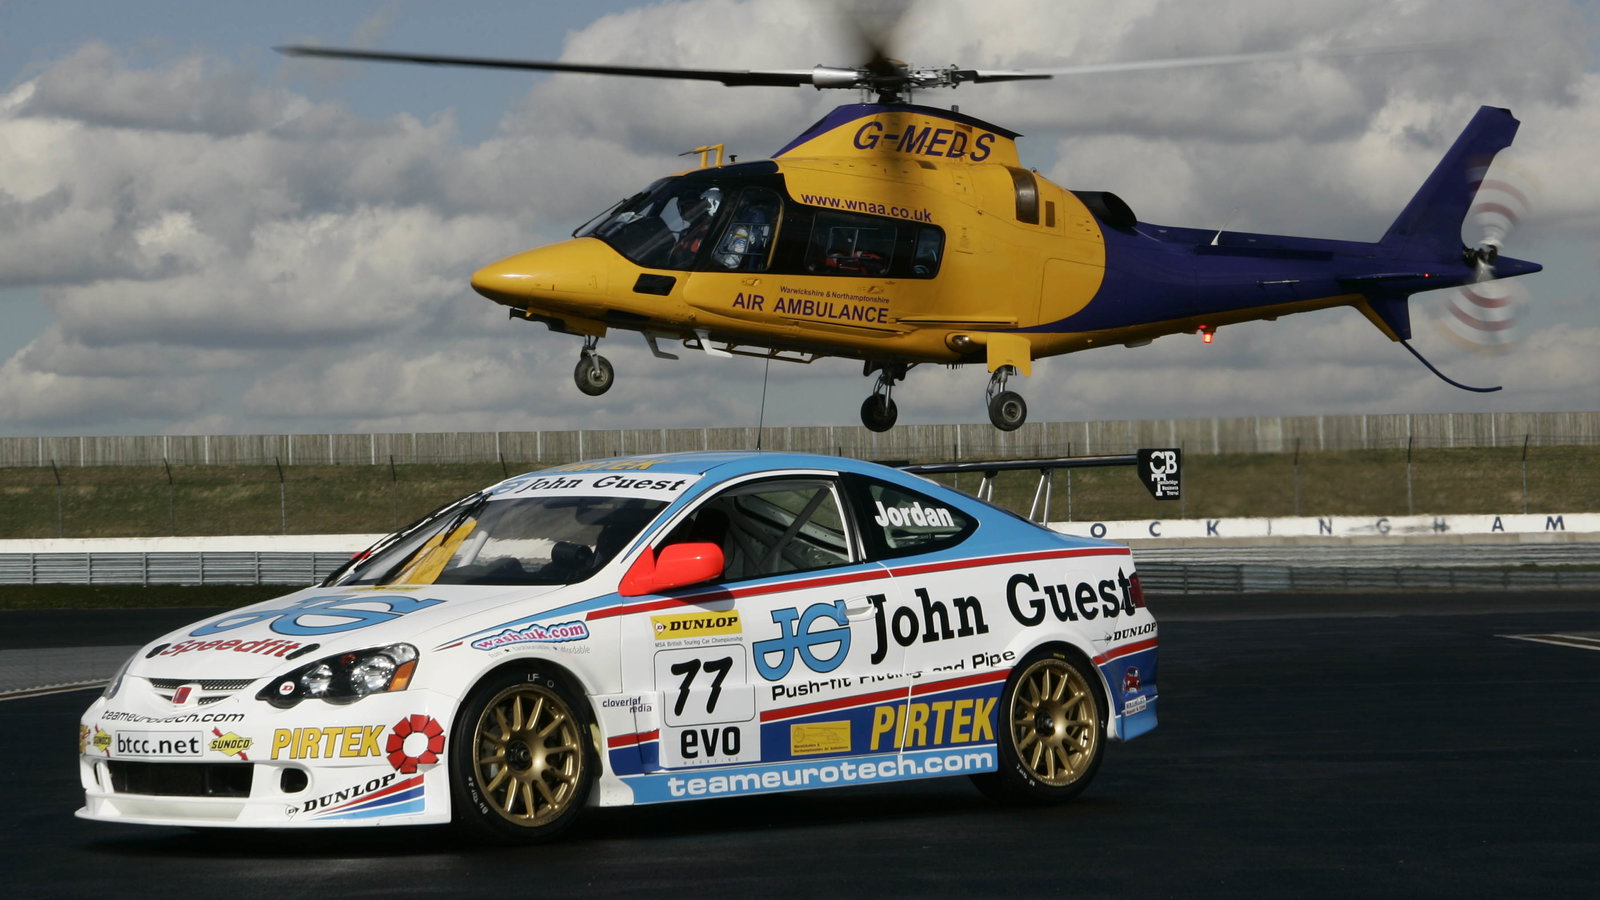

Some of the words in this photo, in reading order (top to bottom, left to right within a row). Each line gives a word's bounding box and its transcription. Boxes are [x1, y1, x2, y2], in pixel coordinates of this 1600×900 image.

[853, 121, 996, 162] G-MEDS
[800, 193, 933, 223] www.wnaa.co.uk
[780, 285, 825, 298] Warwickshire
[832, 291, 890, 304] Northamptonshire
[732, 292, 765, 311] AIR
[773, 297, 889, 324] AMBULANCE
[539, 459, 672, 474] RTEK
[514, 476, 583, 494] John
[592, 475, 687, 491] Guest
[874, 501, 955, 527] Jordan
[669, 616, 738, 631] DUNLOP
[867, 587, 989, 665] John
[1006, 566, 1136, 627] Guest
[477, 624, 585, 649] wash.uk.com
[684, 638, 700, 646] Touring
[1113, 622, 1157, 641] DUNLOP
[160, 638, 302, 657] Speedfit
[972, 650, 1016, 669] Pipe
[671, 656, 733, 717] 77
[101, 710, 245, 723] teameuroch.com
[870, 697, 998, 751] PIRTEK
[117, 733, 200, 753] btcc.net
[211, 739, 251, 749] SUNOCO
[270, 725, 386, 760] PIRTEK
[680, 726, 741, 759] evo
[667, 751, 994, 797] teameurotech.com
[302, 773, 396, 813] DUNLOP
